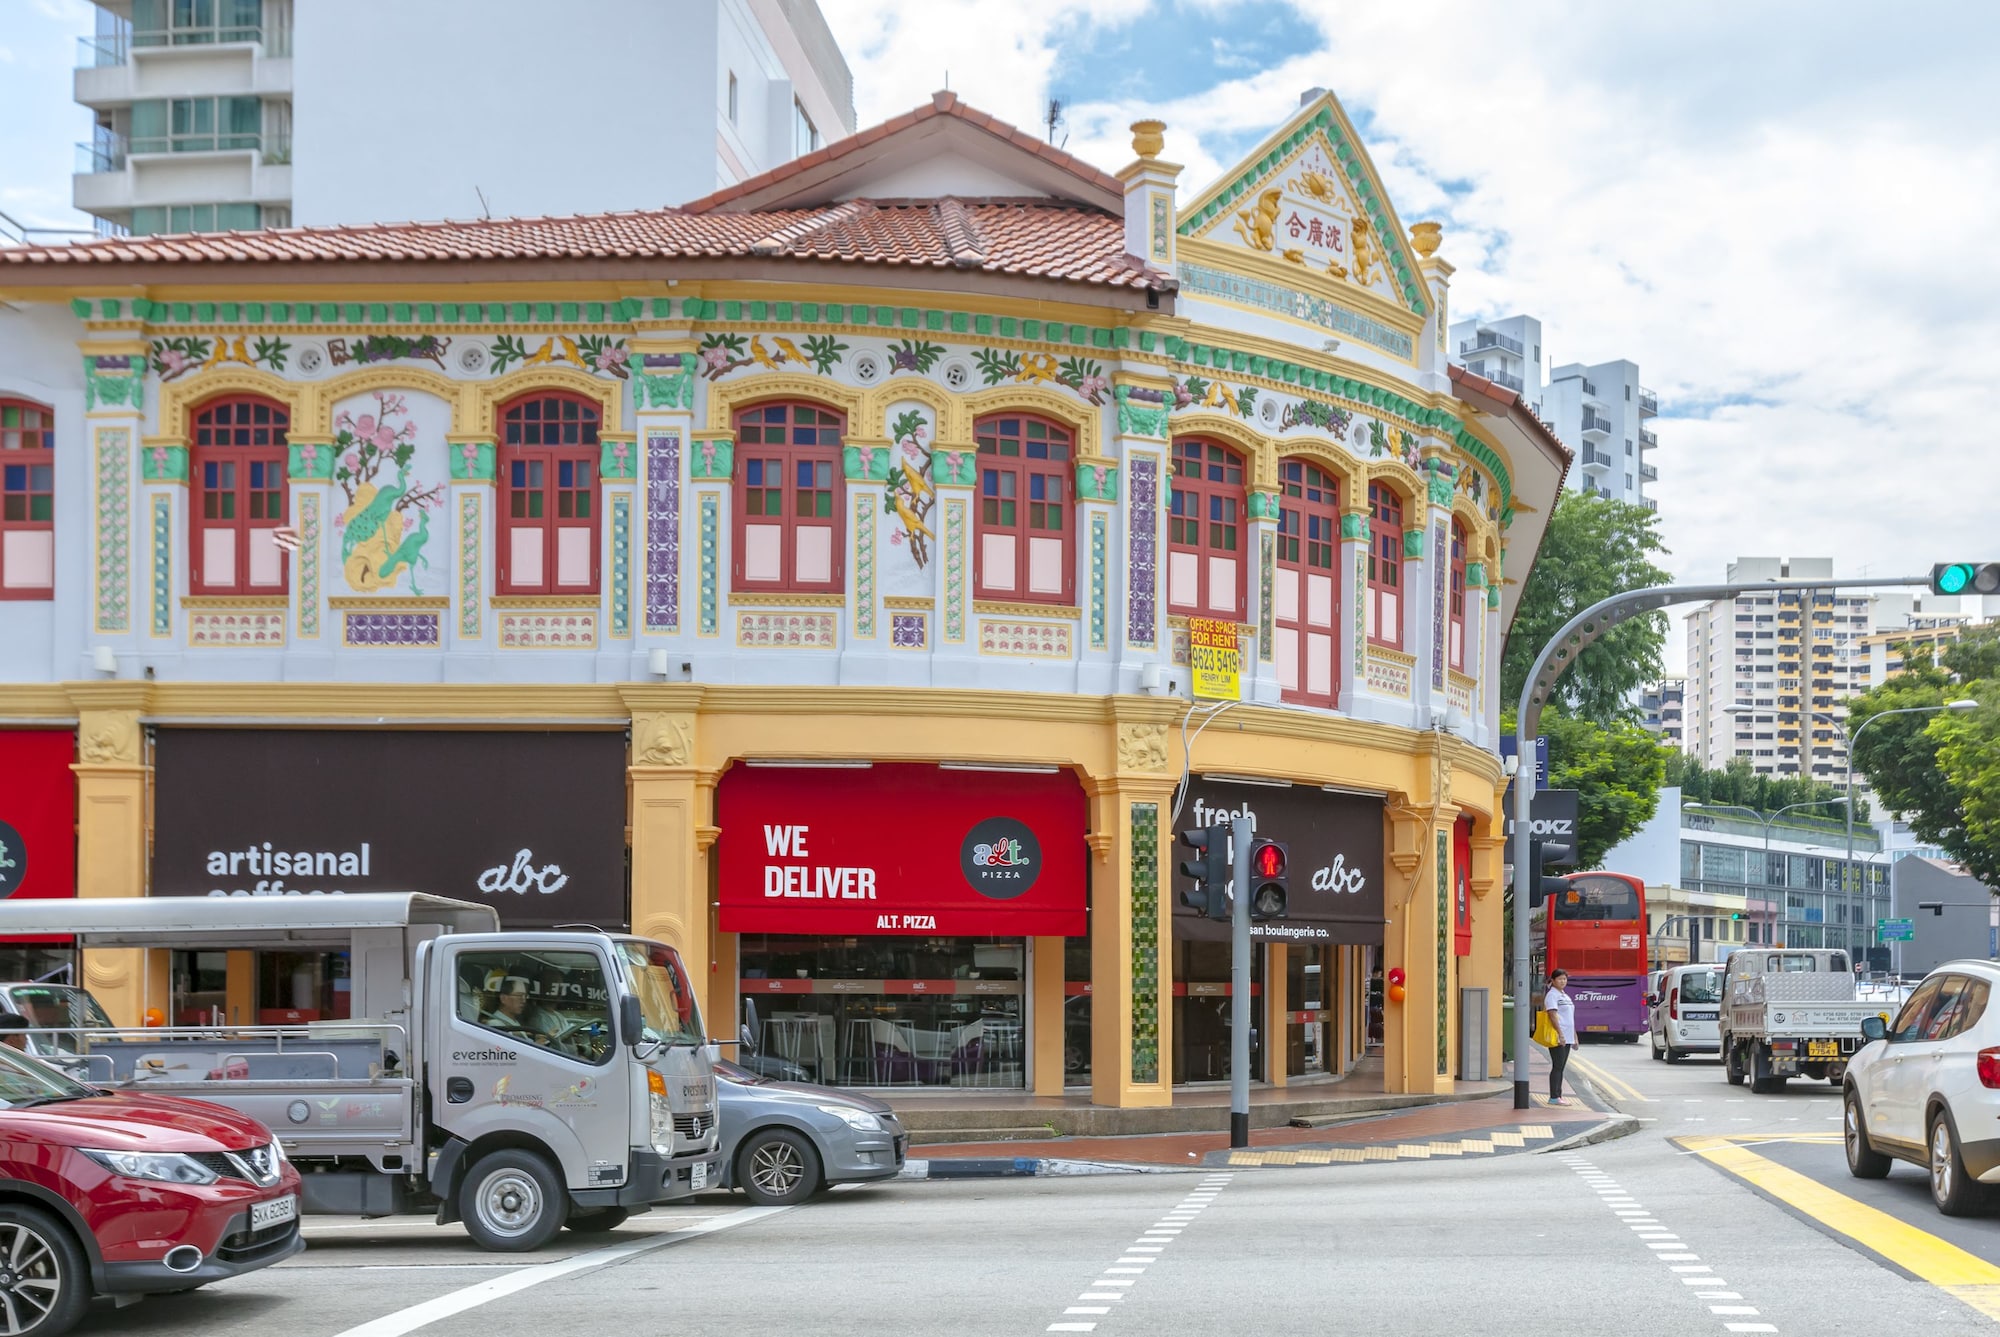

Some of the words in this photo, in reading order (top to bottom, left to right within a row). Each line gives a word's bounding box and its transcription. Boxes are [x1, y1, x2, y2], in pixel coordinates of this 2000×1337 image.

[1190, 617, 1214, 632] OFFICE
[1215, 621, 1237, 635] SPACE
[1191, 631, 1210, 645] FOR
[1212, 633, 1237, 648] RENT
[1192, 646, 1215, 671] 9623
[1216, 650, 1238, 674] 5419
[1201, 673, 1219, 682] HENRY
[1221, 674, 1231, 683] LIM
[763, 824, 809, 857] WE
[206, 841, 370, 876] artisanal
[477, 848, 569, 895] abc
[981, 871, 1021, 879] PIZZA
[1311, 853, 1366, 894] abc
[764, 865, 877, 900] DELIVER
[1842, 880, 1860, 893] MTH
[876, 915, 902, 929] ALT.
[903, 915, 937, 929] PIZZA
[1265, 925, 1315, 938] boulangerie
[1316, 927, 1330, 937] co.
[1574, 993, 1588, 1001] SBS
[1588, 991, 1618, 1001] Transit
[452, 1045, 518, 1061] evershine
